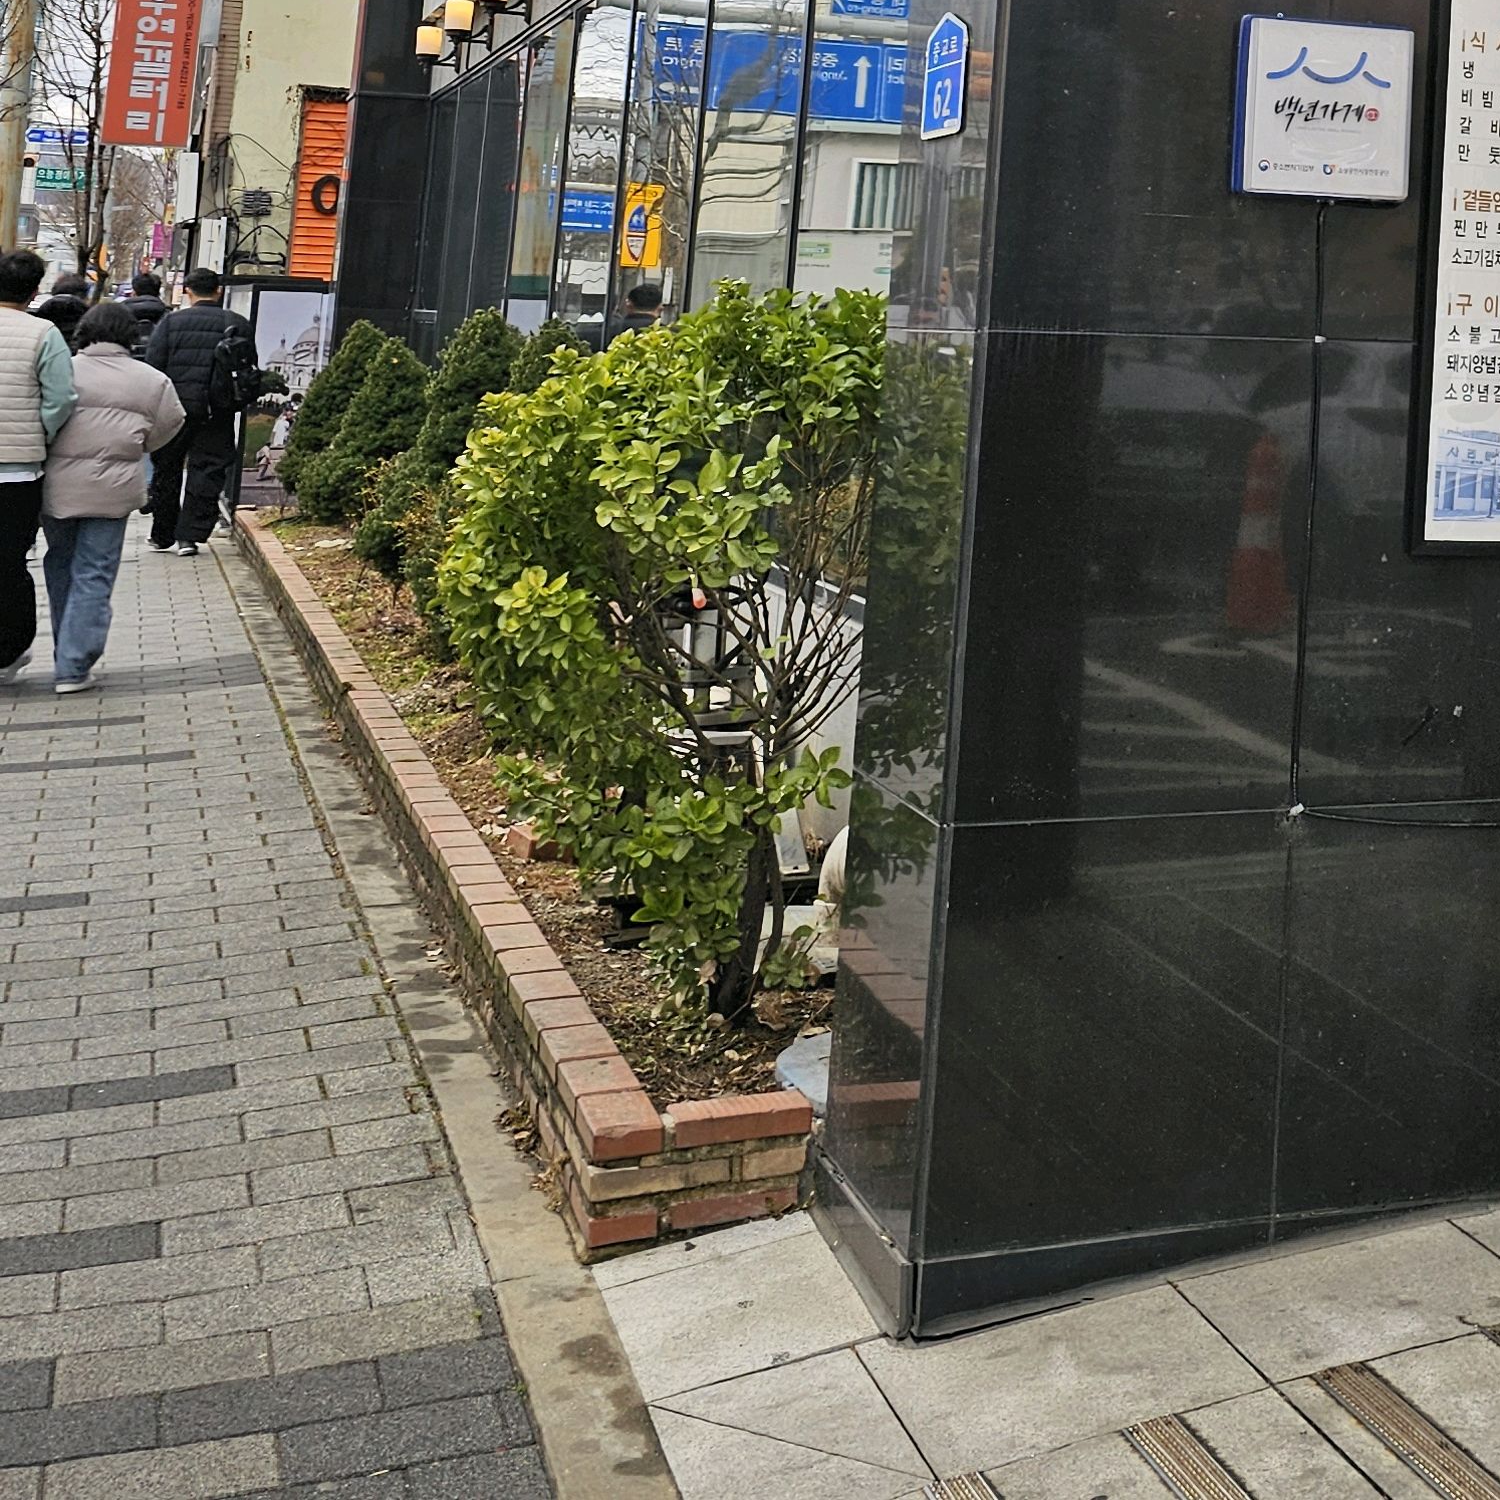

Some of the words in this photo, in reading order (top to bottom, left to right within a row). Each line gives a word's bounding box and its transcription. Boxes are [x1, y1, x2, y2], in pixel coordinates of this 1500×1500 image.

[933, 36, 958, 65] 중교로
[933, 77, 952, 119] 62
[1274, 95, 1366, 132] 백년가게
